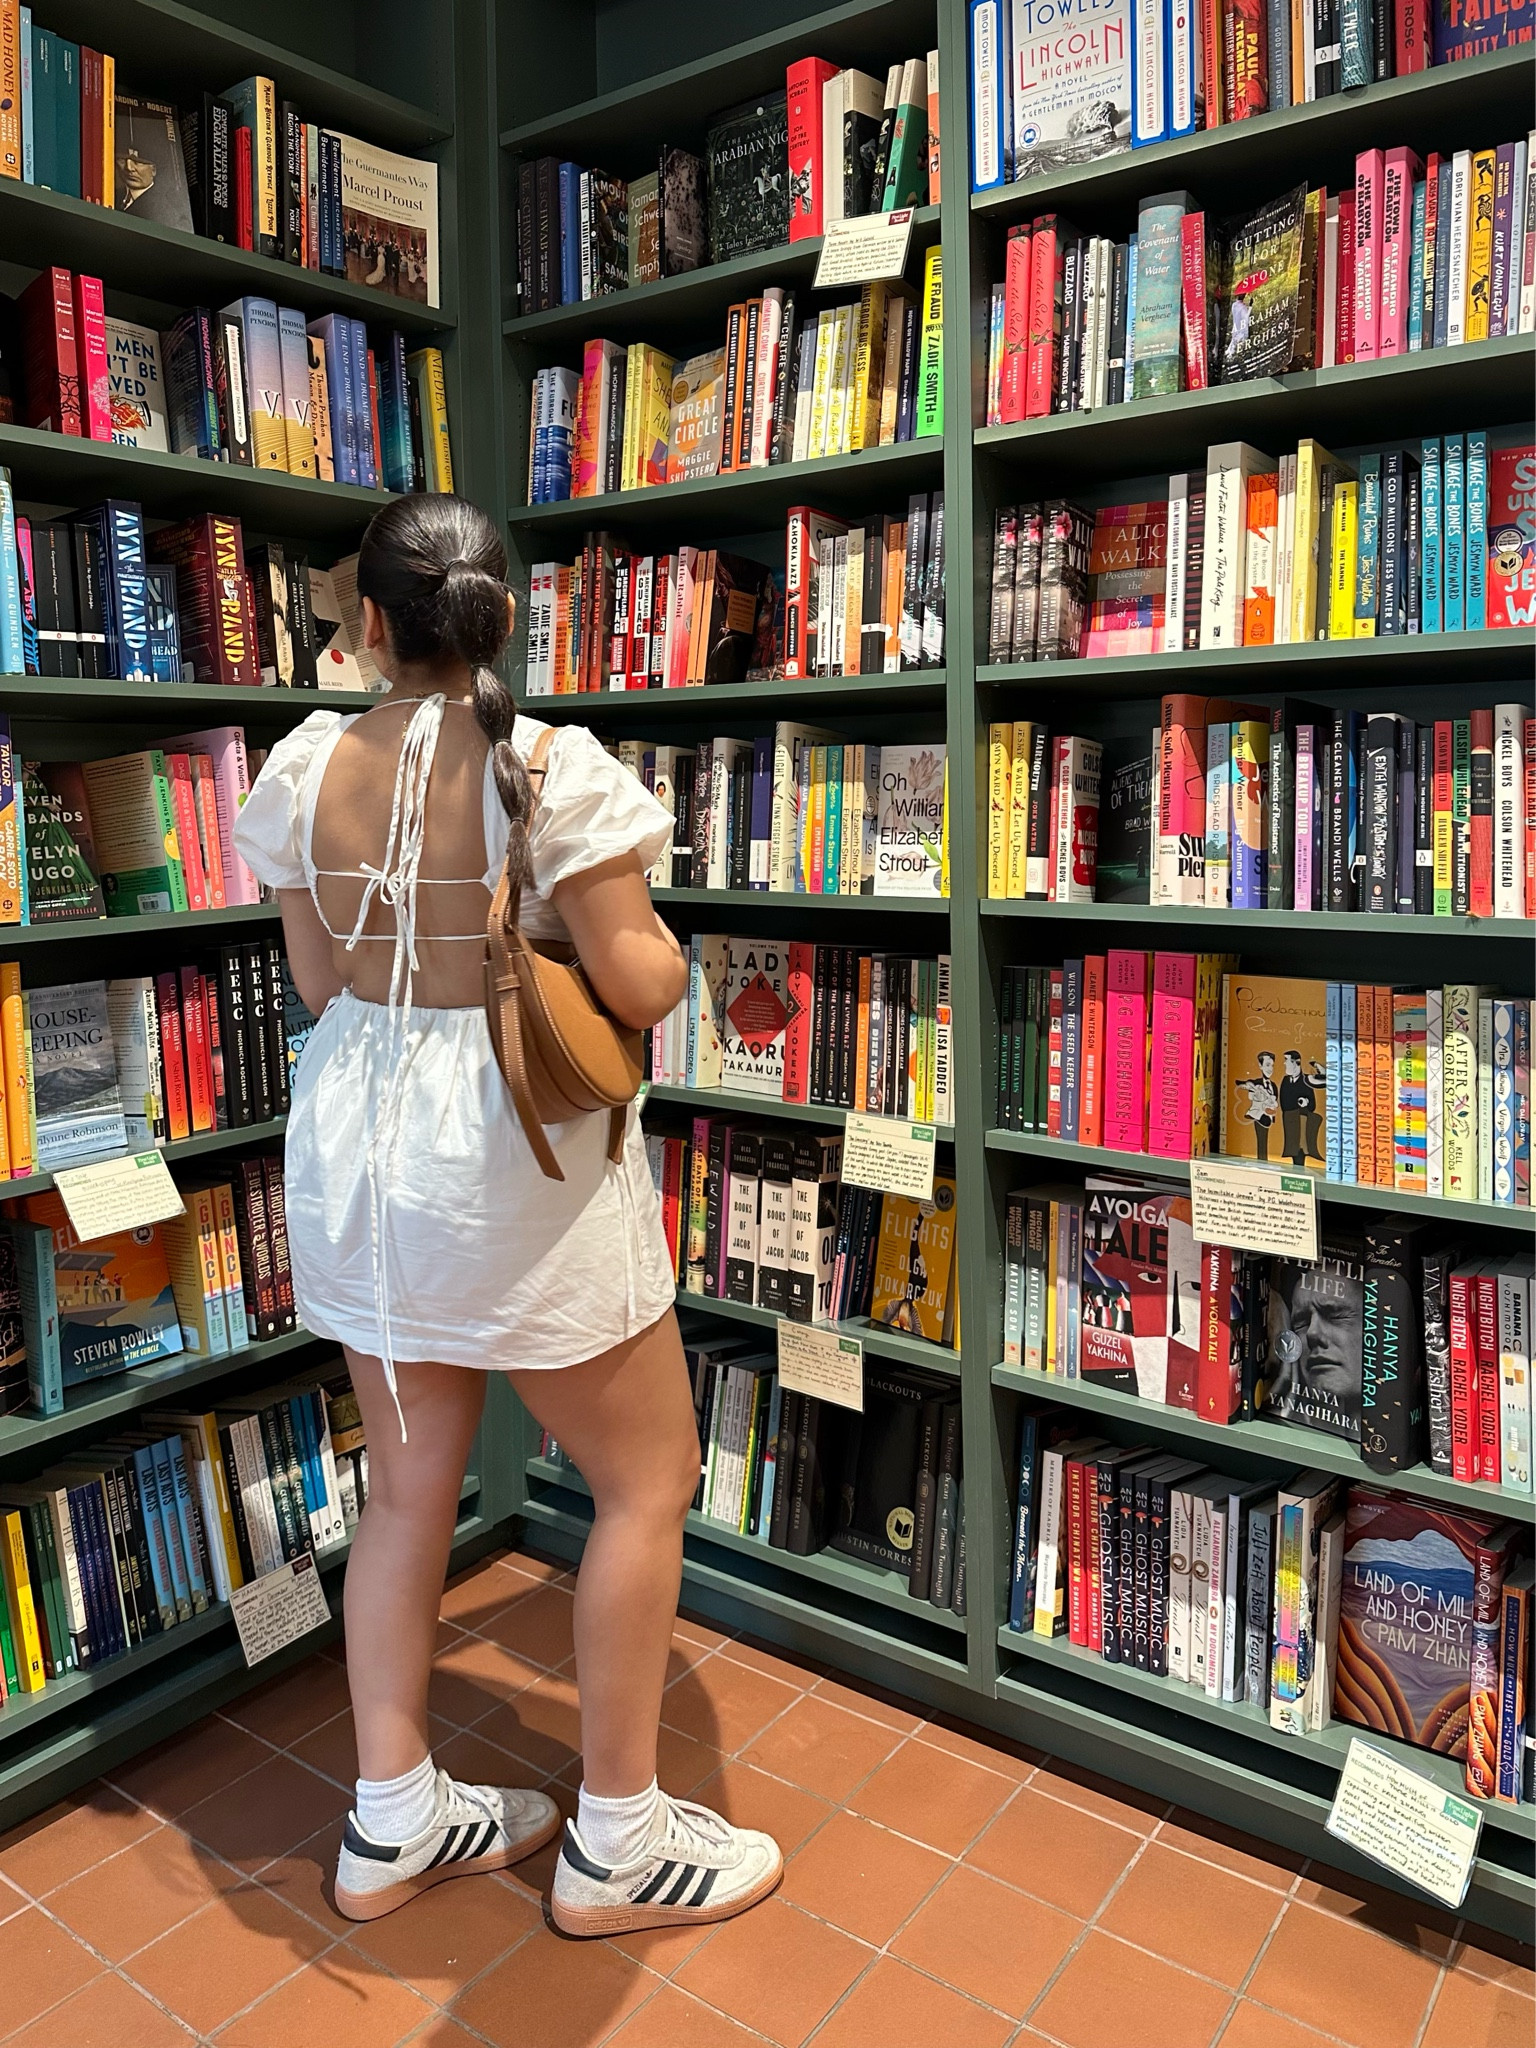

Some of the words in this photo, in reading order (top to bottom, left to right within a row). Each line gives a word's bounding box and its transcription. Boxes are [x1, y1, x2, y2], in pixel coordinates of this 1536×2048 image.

[2, 10, 14, 44] MAD
[1062, 21, 1077, 33] The
[1405, 5, 1414, 49] ROSE
[1020, 18, 1124, 90] LINCOLN
[1041, 52, 1100, 82] HIGHWAY
[1235, 20, 1248, 100] TREMBLAY
[1246, 31, 1258, 81] PAUL
[3, 46, 15, 98] HONEY
[1054, 82, 1060, 90] A
[1063, 75, 1088, 88] NOVEL
[213, 106, 221, 146] EDGAR
[213, 148, 222, 182] ALLAN
[320, 136, 328, 193] Bewilderment
[714, 139, 764, 165] ARABIAN
[355, 160, 407, 184] Guermantes
[408, 175, 430, 190] Way
[1388, 168, 1395, 184] OF
[1394, 171, 1402, 195] THE
[1455, 171, 1463, 193] BORIS
[213, 184, 222, 205] POE
[343, 174, 380, 200] Marcel
[384, 189, 423, 211] Proust
[1455, 195, 1463, 220] VIAN
[1151, 222, 1166, 232] The
[1385, 186, 1395, 243] BABYLON
[1392, 197, 1402, 235] TOWN
[1138, 235, 1179, 250] Covenant
[1235, 213, 1296, 252] CUTTING
[1495, 231, 1504, 257] KURT
[932, 257, 942, 279] THE
[1154, 249, 1164, 260] of
[1252, 245, 1279, 265] FOR
[1451, 223, 1462, 302] HEARTSNATCHER
[1065, 255, 1075, 304] BLIZZARD
[1144, 264, 1171, 276] Water
[1242, 261, 1285, 290] STONE
[930, 282, 941, 320] FRAUD
[1491, 258, 1504, 318] VONNEGUT
[250, 318, 276, 329] PYNCHON
[251, 309, 275, 319] THOMAS
[763, 297, 772, 329] ROMANTIC
[1140, 302, 1173, 315] Abraham
[1140, 310, 1172, 323] Verghese
[116, 336, 154, 360] MEN
[759, 331, 768, 362] COMEDY
[928, 335, 940, 370] ZADIE
[139, 364, 157, 381] BE
[432, 354, 446, 412] MEDEA
[757, 373, 765, 397] CURTIS
[258, 389, 282, 420] V.
[925, 372, 938, 413] SMITH
[679, 395, 717, 423] GREAT
[753, 399, 764, 437] SITTENFELD
[675, 416, 718, 445] CIRCLE
[670, 463, 715, 484] SHIPSTEAD
[678, 450, 711, 468] MAGGIE
[1388, 455, 1397, 473] THE
[1468, 441, 1484, 487] SALVAGE
[1386, 477, 1397, 503] COLD
[1472, 488, 1480, 500] THE
[1385, 505, 1396, 554] MILLIONS
[1469, 501, 1484, 535] BONES
[115, 510, 141, 562] AYN
[214, 519, 237, 568] AYN
[791, 517, 799, 561] CAHOKIA
[542, 576, 552, 589] NW
[1105, 569, 1152, 582] Possessing
[1385, 558, 1395, 580] JESS
[1115, 594, 1144, 605] Secret
[1128, 580, 1143, 590] the
[119, 579, 147, 649] RAND
[1118, 608, 1127, 619] of
[1384, 582, 1394, 619] WALTER
[220, 597, 246, 664] RAND
[541, 604, 551, 629] ZADIE
[1127, 618, 1143, 630] Joy
[539, 631, 550, 662] SMITH
[1299, 731, 1309, 752] THE
[1334, 719, 1343, 739] THE
[233, 732, 241, 753] Greta
[237, 764, 245, 789] Valdin
[1501, 729, 1513, 764] NICKEL
[1298, 754, 1309, 800] BREAKUP
[1334, 742, 1342, 788] CLEANER
[1501, 765, 1513, 788] BOYS
[24, 781, 43, 790] The
[882, 772, 907, 792] Oh
[1297, 804, 1309, 836] TOUR
[1333, 807, 1342, 845] BRANDI
[1501, 800, 1513, 833] COLSON
[36, 830, 47, 840] of
[879, 852, 930, 873] Strout
[1333, 849, 1342, 882] WELLS
[1501, 837, 1513, 888] WHITEHEAD
[251, 956, 264, 1018] HERC
[939, 962, 950, 1004] ANIMAL
[1066, 1013, 1076, 1031] THE
[937, 1028, 947, 1053] LISA
[1066, 1032, 1075, 1055] SEED
[45, 1051, 84, 1061] NOVEL
[936, 1057, 947, 1095] TADDEO
[1065, 1057, 1075, 1088] KEEPER
[1116, 1026, 1133, 1120] WODEHOUSE
[73, 1122, 119, 1138] Robinson
[249, 1179, 264, 1230] DESTROYER
[739, 1184, 750, 1195] THE
[734, 1201, 752, 1214] BOOKS
[1089, 1196, 1101, 1214] A
[1103, 1198, 1168, 1226] VOLGA
[739, 1220, 746, 1231] OF
[885, 1211, 949, 1250] FLIGHTS
[220, 1199, 240, 1309] GUNCLE
[732, 1237, 751, 1250] JACOB
[1089, 1215, 1168, 1267] TALE
[258, 1240, 271, 1280] WORLDS
[899, 1254, 927, 1278] OLGA
[879, 1273, 943, 1310] TOKARCZUK
[1301, 1273, 1346, 1299] LIFE
[1451, 1280, 1468, 1350] NIGHTBITCH
[73, 1342, 117, 1366] STEVEN
[121, 1324, 165, 1351] ROWLEY
[130, 1349, 140, 1359] THE
[141, 1344, 159, 1357] GUNCLE
[1087, 1343, 1128, 1365] YAKHINA
[1092, 1331, 1122, 1350] GUZEL
[1362, 1281, 1380, 1408] YANAGIHARA
[1383, 1316, 1399, 1382] HANYA
[1291, 1380, 1339, 1408] HANYA
[1452, 1358, 1468, 1402] RACHEL
[1269, 1392, 1360, 1432] YANAGIHARA
[1454, 1407, 1468, 1445] YODER
[173, 1454, 183, 1479] LAST
[175, 1480, 187, 1499] ACTS
[1098, 1513, 1113, 1577] GHOST
[1354, 1566, 1395, 1595] LAND
[1401, 1581, 1432, 1605] OF
[1101, 1582, 1114, 1641] MUSIC
[1366, 1594, 1396, 1621] AND
[1403, 1608, 1467, 1643] HONEY
[1209, 1623, 1217, 1637] MY
[1208, 1640, 1217, 1688] DOCUMENTS
[626, 1878, 648, 1900] SPEZIAL
[587, 1919, 617, 1930] adidas
